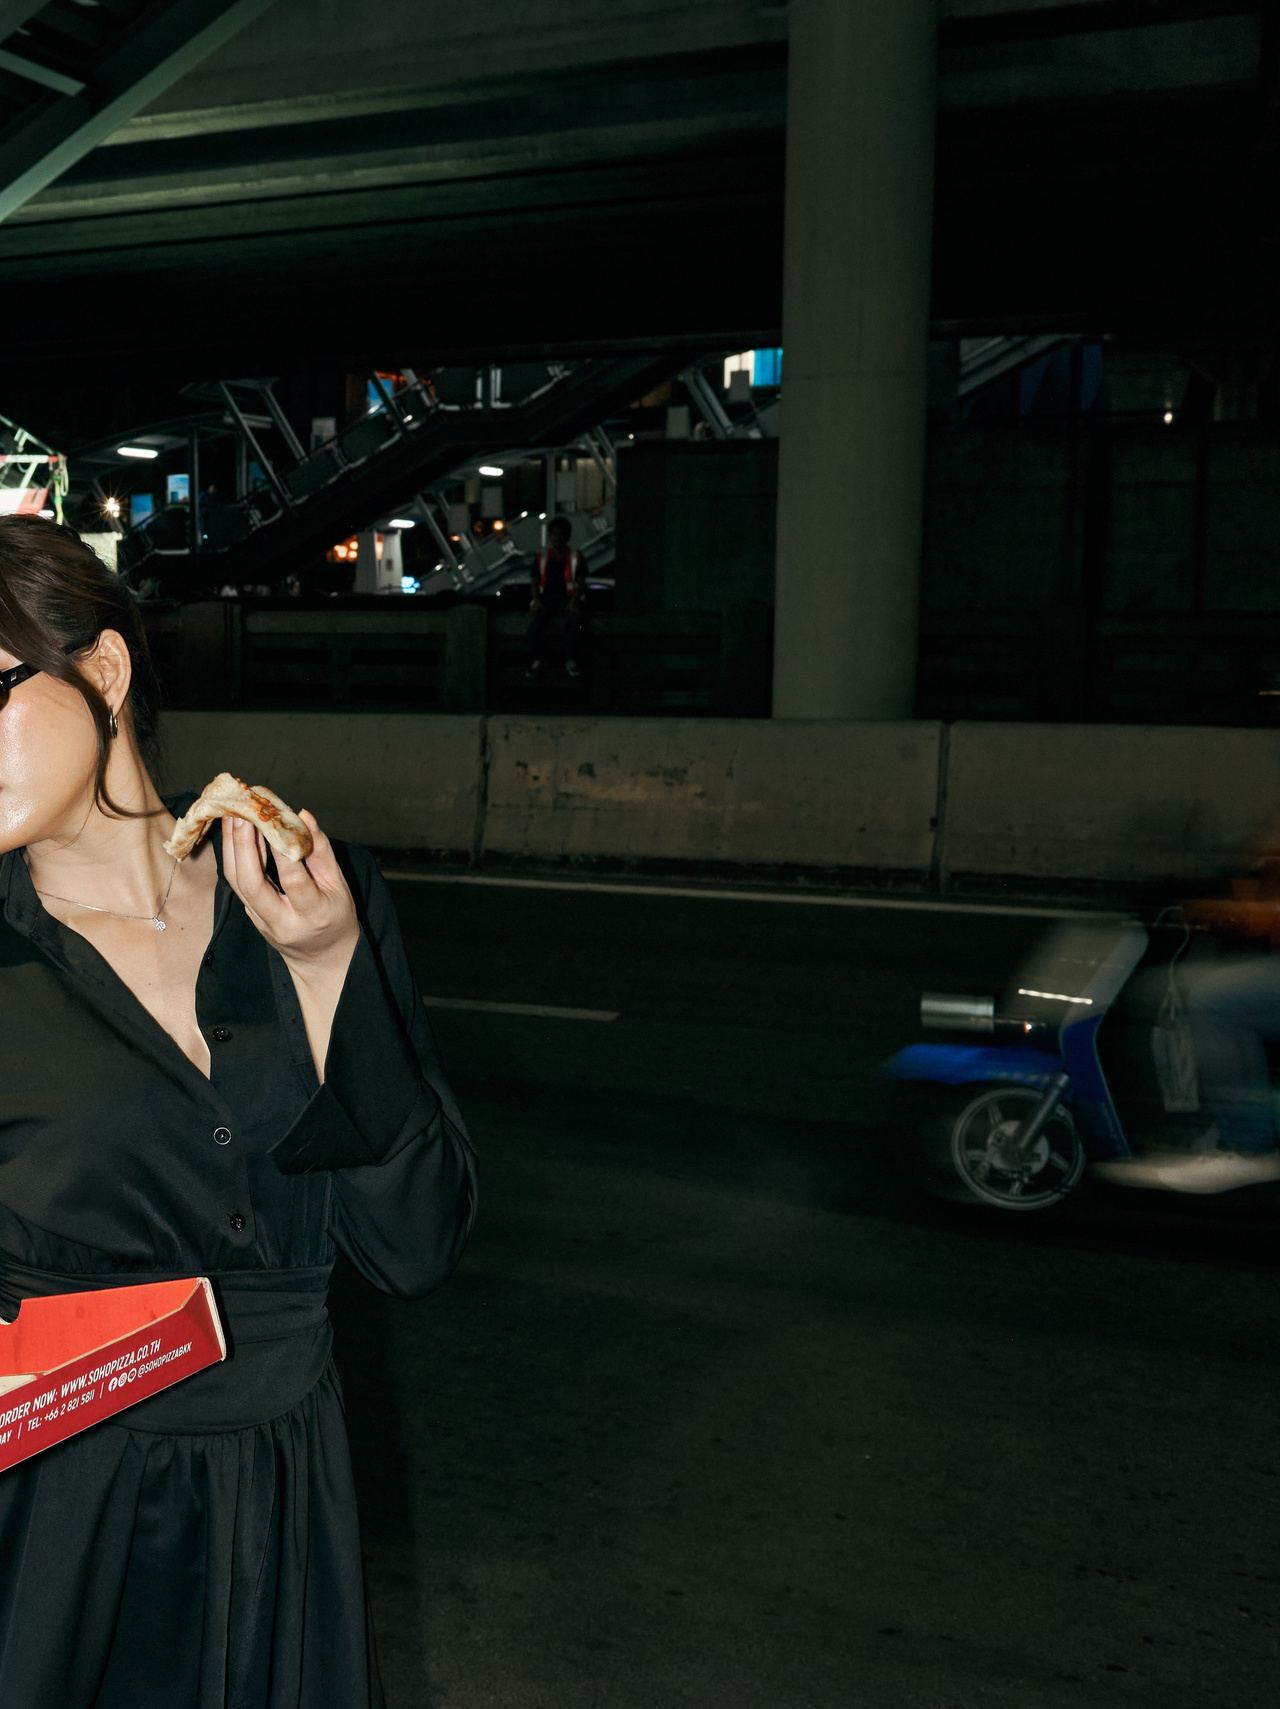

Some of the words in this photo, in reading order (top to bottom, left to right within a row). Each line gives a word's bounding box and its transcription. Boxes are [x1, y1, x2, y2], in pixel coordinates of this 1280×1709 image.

[27, 1416, 43, 1432] TEL:
[44, 1409, 59, 1422] +66
[60, 1404, 66, 1416] 2
[67, 1400, 80, 1412] 821
[137, 1341, 193, 1378] @SOHOPIZZABKK
[32, 1390, 58, 1413] NOW:
[61, 1338, 162, 1399] WWW.SOHOPIZZA.CO.TH
